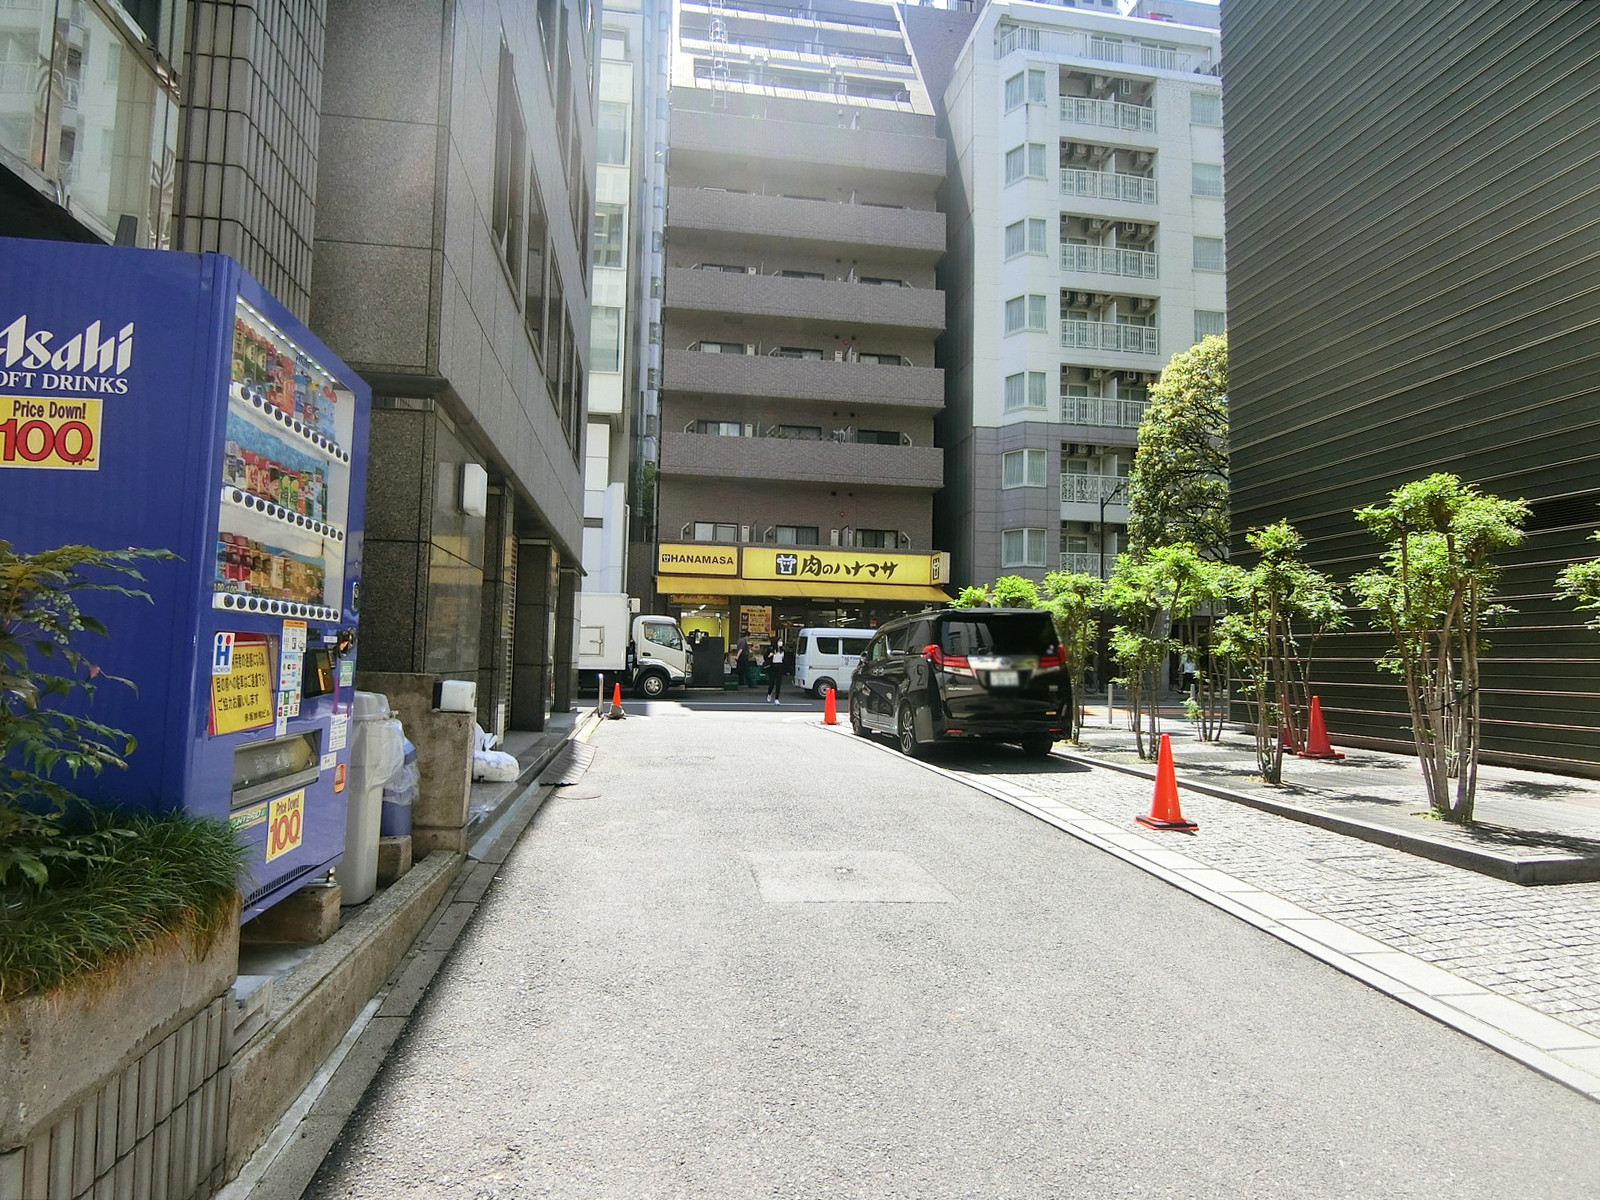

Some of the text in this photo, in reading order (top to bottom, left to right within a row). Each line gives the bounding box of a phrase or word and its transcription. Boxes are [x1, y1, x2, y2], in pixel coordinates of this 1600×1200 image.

[0, 315, 134, 375] Asahi
[42, 373, 129, 395] DRINKS
[13, 400, 86, 420] Price Down!
[0, 418, 93, 462] 100
[670, 554, 734, 565] HANAMASA
[800, 554, 898, 579] 肉のハナマサ
[270, 809, 301, 855] 100
